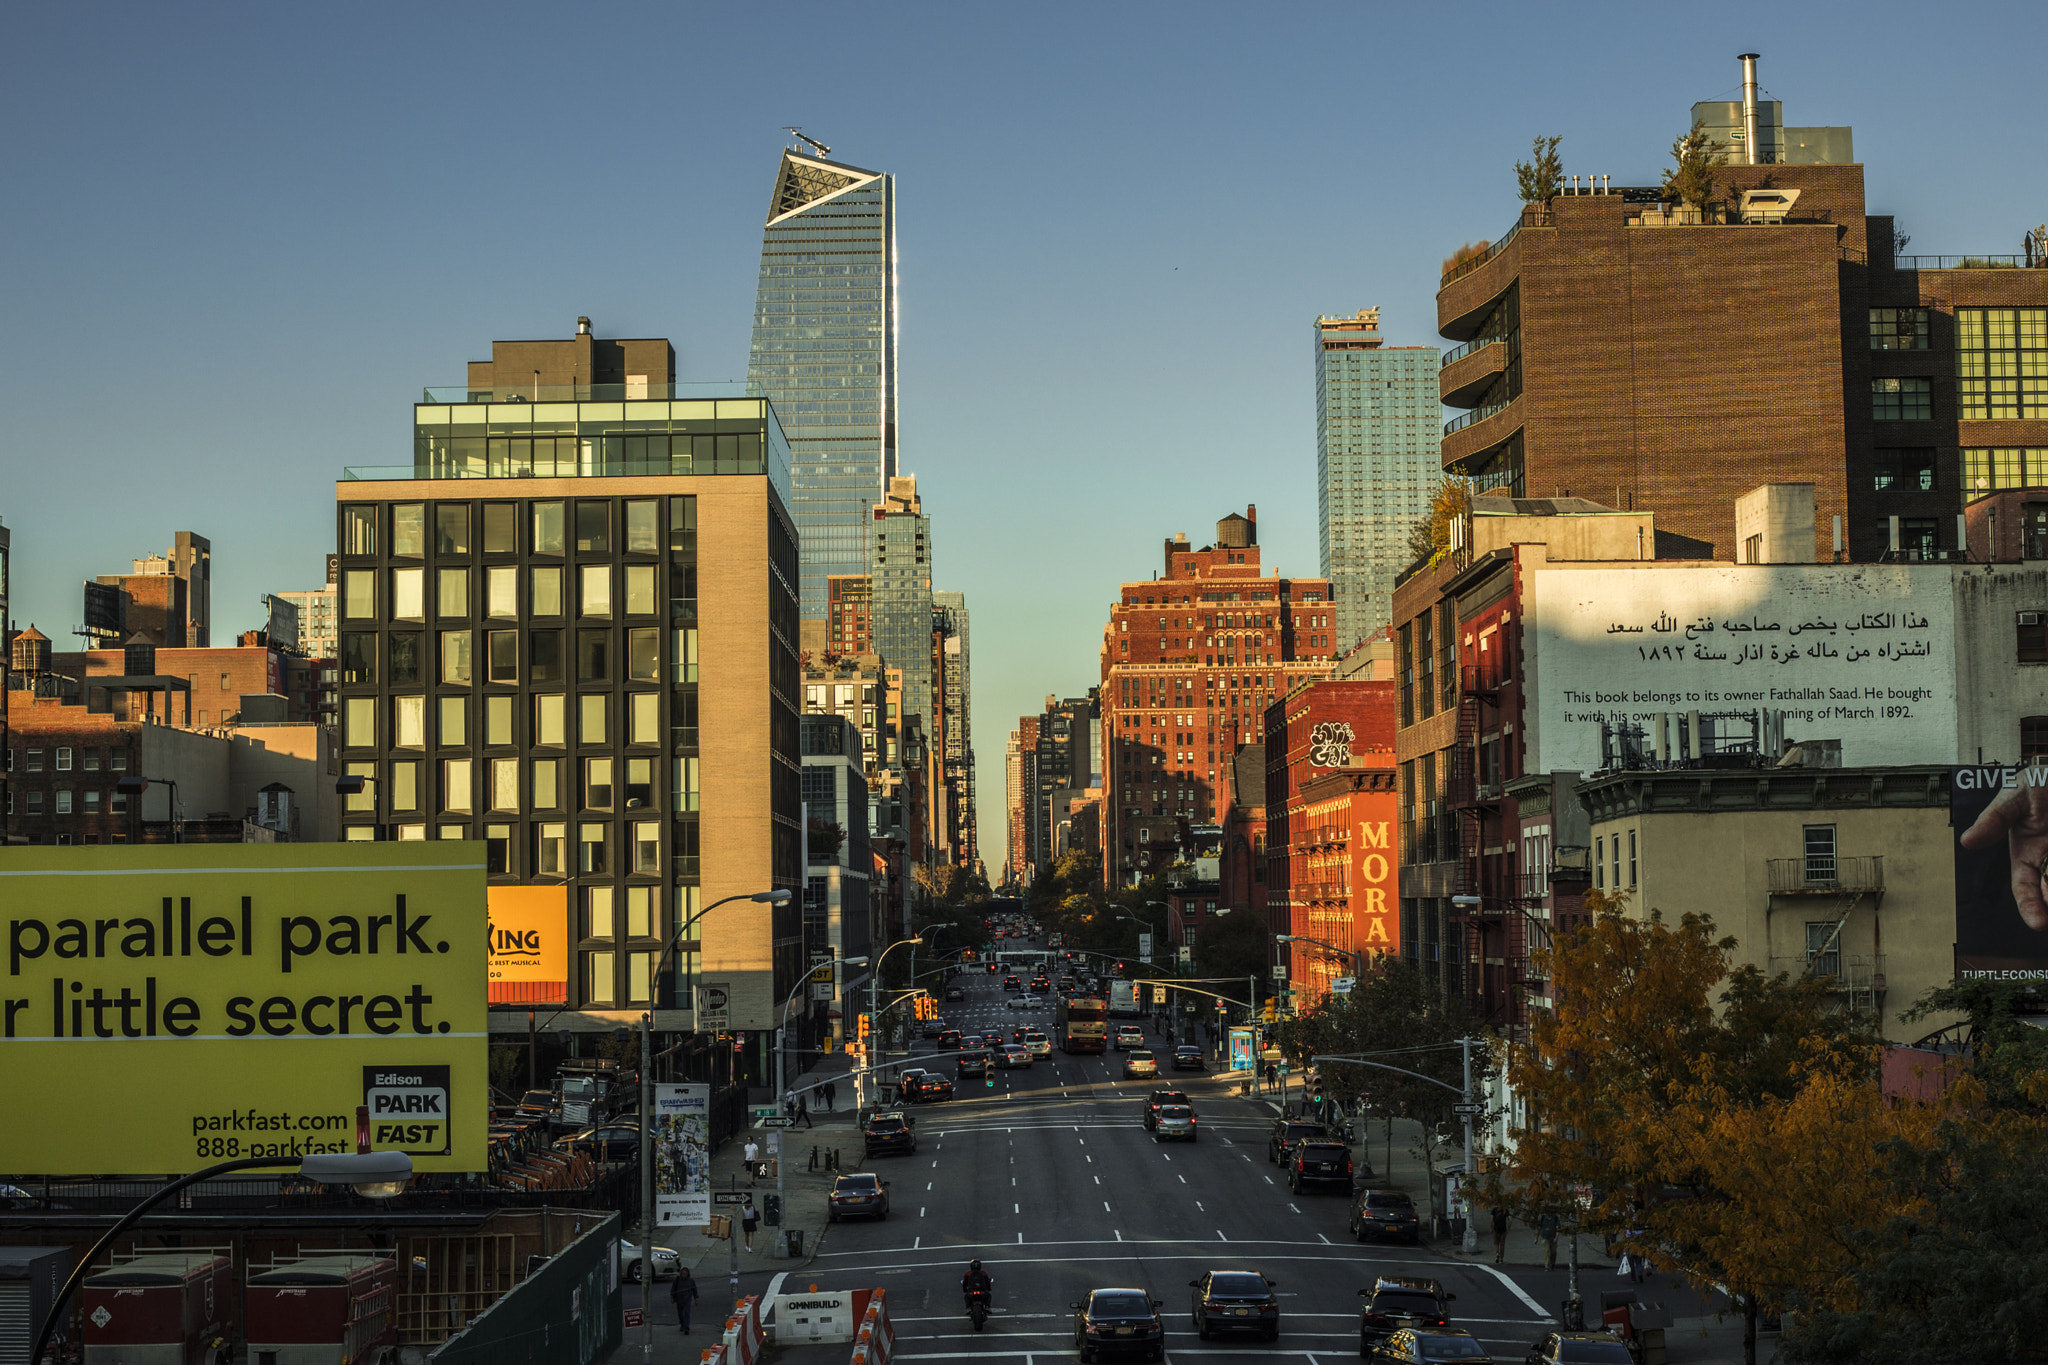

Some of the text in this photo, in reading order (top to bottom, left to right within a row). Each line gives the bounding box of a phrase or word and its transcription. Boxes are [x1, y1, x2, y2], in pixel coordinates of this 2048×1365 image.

[1606, 622, 1644, 634] سعد
[1685, 616, 1714, 640] فتح
[1722, 615, 1781, 637] صاحبه
[1788, 615, 1837, 636] يخص
[1845, 612, 1895, 636] الكتاب
[1902, 612, 1929, 629] هذا
[1638, 641, 1930, 666] اشتراه من ماله غرة اذار سنة ١٨٩٢
[1563, 687, 1932, 705] This book belongs to its owner Fathallah Saad. He bought
[1564, 711, 1573, 722] it
[1577, 710, 1605, 722] with
[1610, 709, 1627, 722] his
[1729, 707, 1749, 720] the
[1818, 706, 1831, 718] of
[1835, 706, 1874, 718] March
[1881, 705, 1914, 718] 1892.
[1956, 768, 2018, 790] GIVE
[1359, 821, 1391, 971] MORAN
[10, 894, 451, 975] parallel park.
[810, 958, 829, 967] ARK
[809, 970, 829, 979] AST
[54, 977, 201, 1037] little
[226, 984, 452, 1037] secret.
[375, 1073, 423, 1085] Edison
[375, 1094, 442, 1114] PARK
[192, 1109, 348, 1137] parkfast.com
[376, 1124, 439, 1144] FAST
[196, 1137, 349, 1158] 888-parkfast
[789, 1300, 840, 1310] OMNIBUILD
